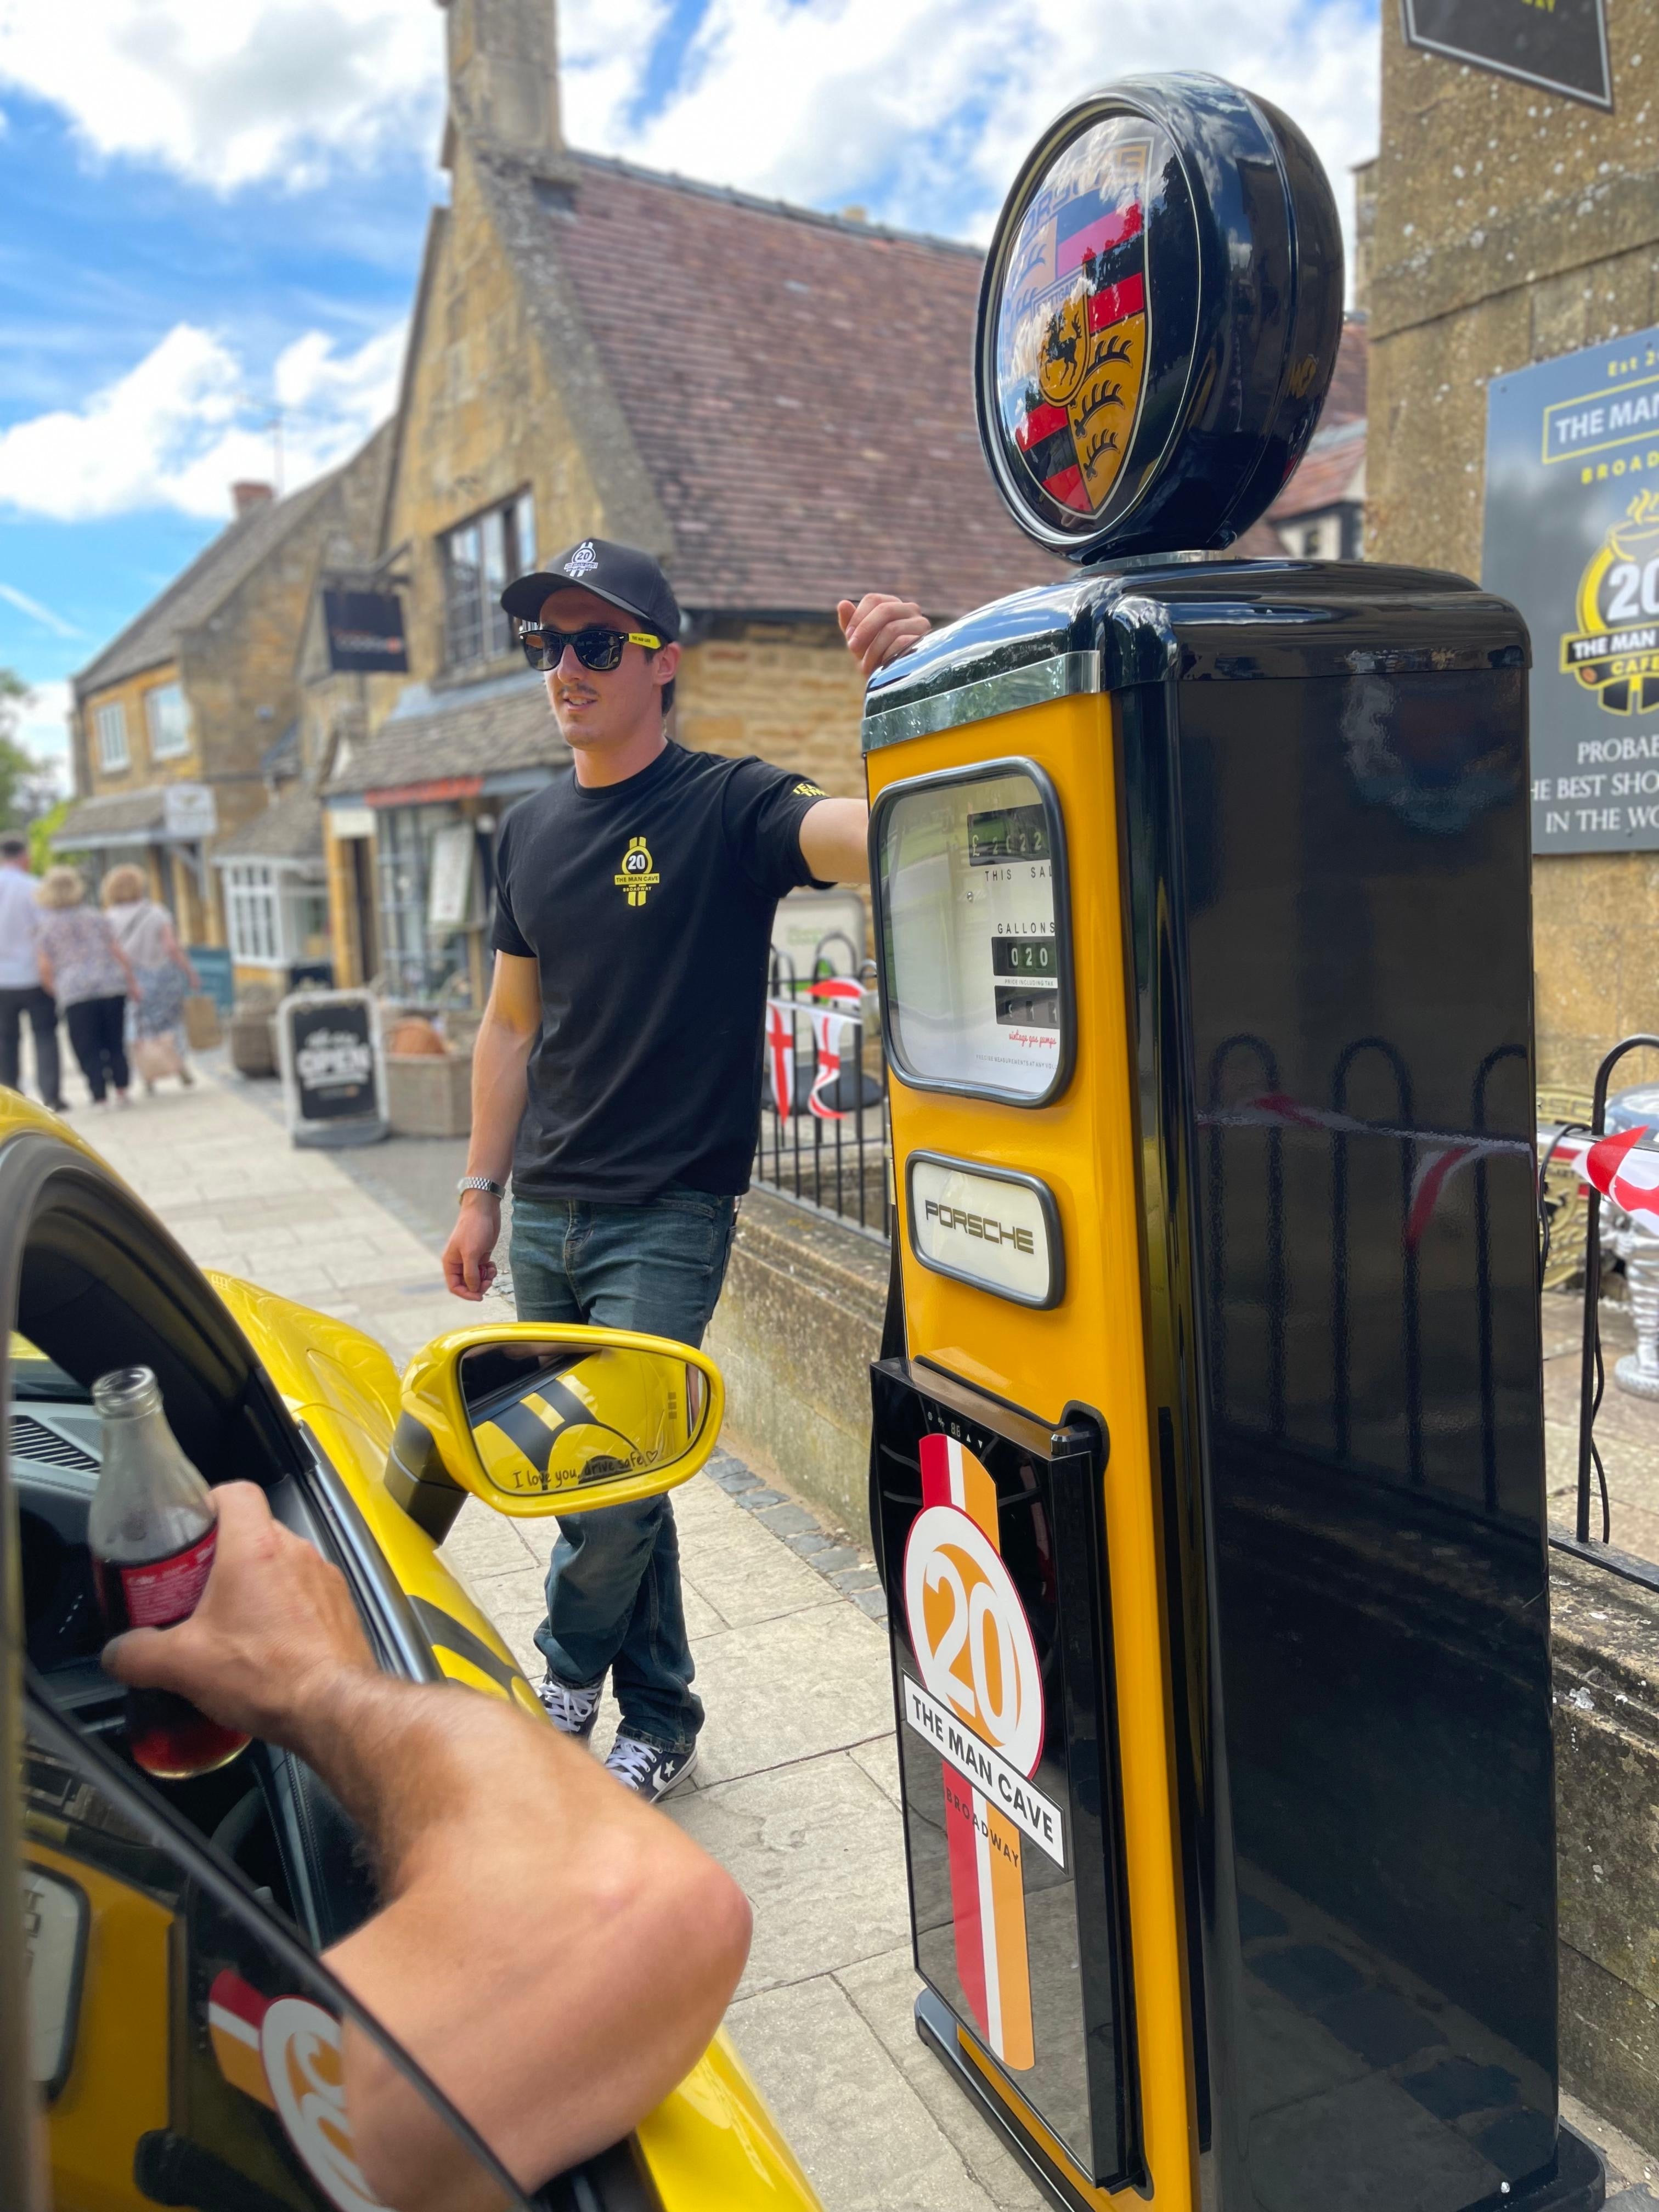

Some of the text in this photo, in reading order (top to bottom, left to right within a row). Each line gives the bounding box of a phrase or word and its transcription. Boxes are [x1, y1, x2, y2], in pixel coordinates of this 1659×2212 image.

[1646, 349, 1659, 367] 2
[1554, 408, 1605, 444] THE
[577, 551, 590, 560] 20
[1572, 629, 1656, 660] THE MAN
[1556, 774, 1608, 800] BEST
[1611, 769, 1659, 796] SHO
[1545, 810, 1571, 833] IN
[1575, 806, 1621, 832] THE
[628, 854, 646, 870] 20
[985, 868, 1012, 882] THIS
[997, 922, 1055, 934] GALLONS
[1009, 1029, 1057, 1049] vintage gas pumps
[975, 1054, 993, 1063] PRECISE
[994, 1056, 1029, 1066] MEASUREMENTS
[925, 1199, 1034, 1255] PORSCHE
[513, 1452, 644, 1488] I love you, drive safe
[924, 1549, 1020, 1745] 20
[912, 1694, 1054, 1844] THE MAN CAVE
[946, 1786, 1019, 1869] BROADWAY
